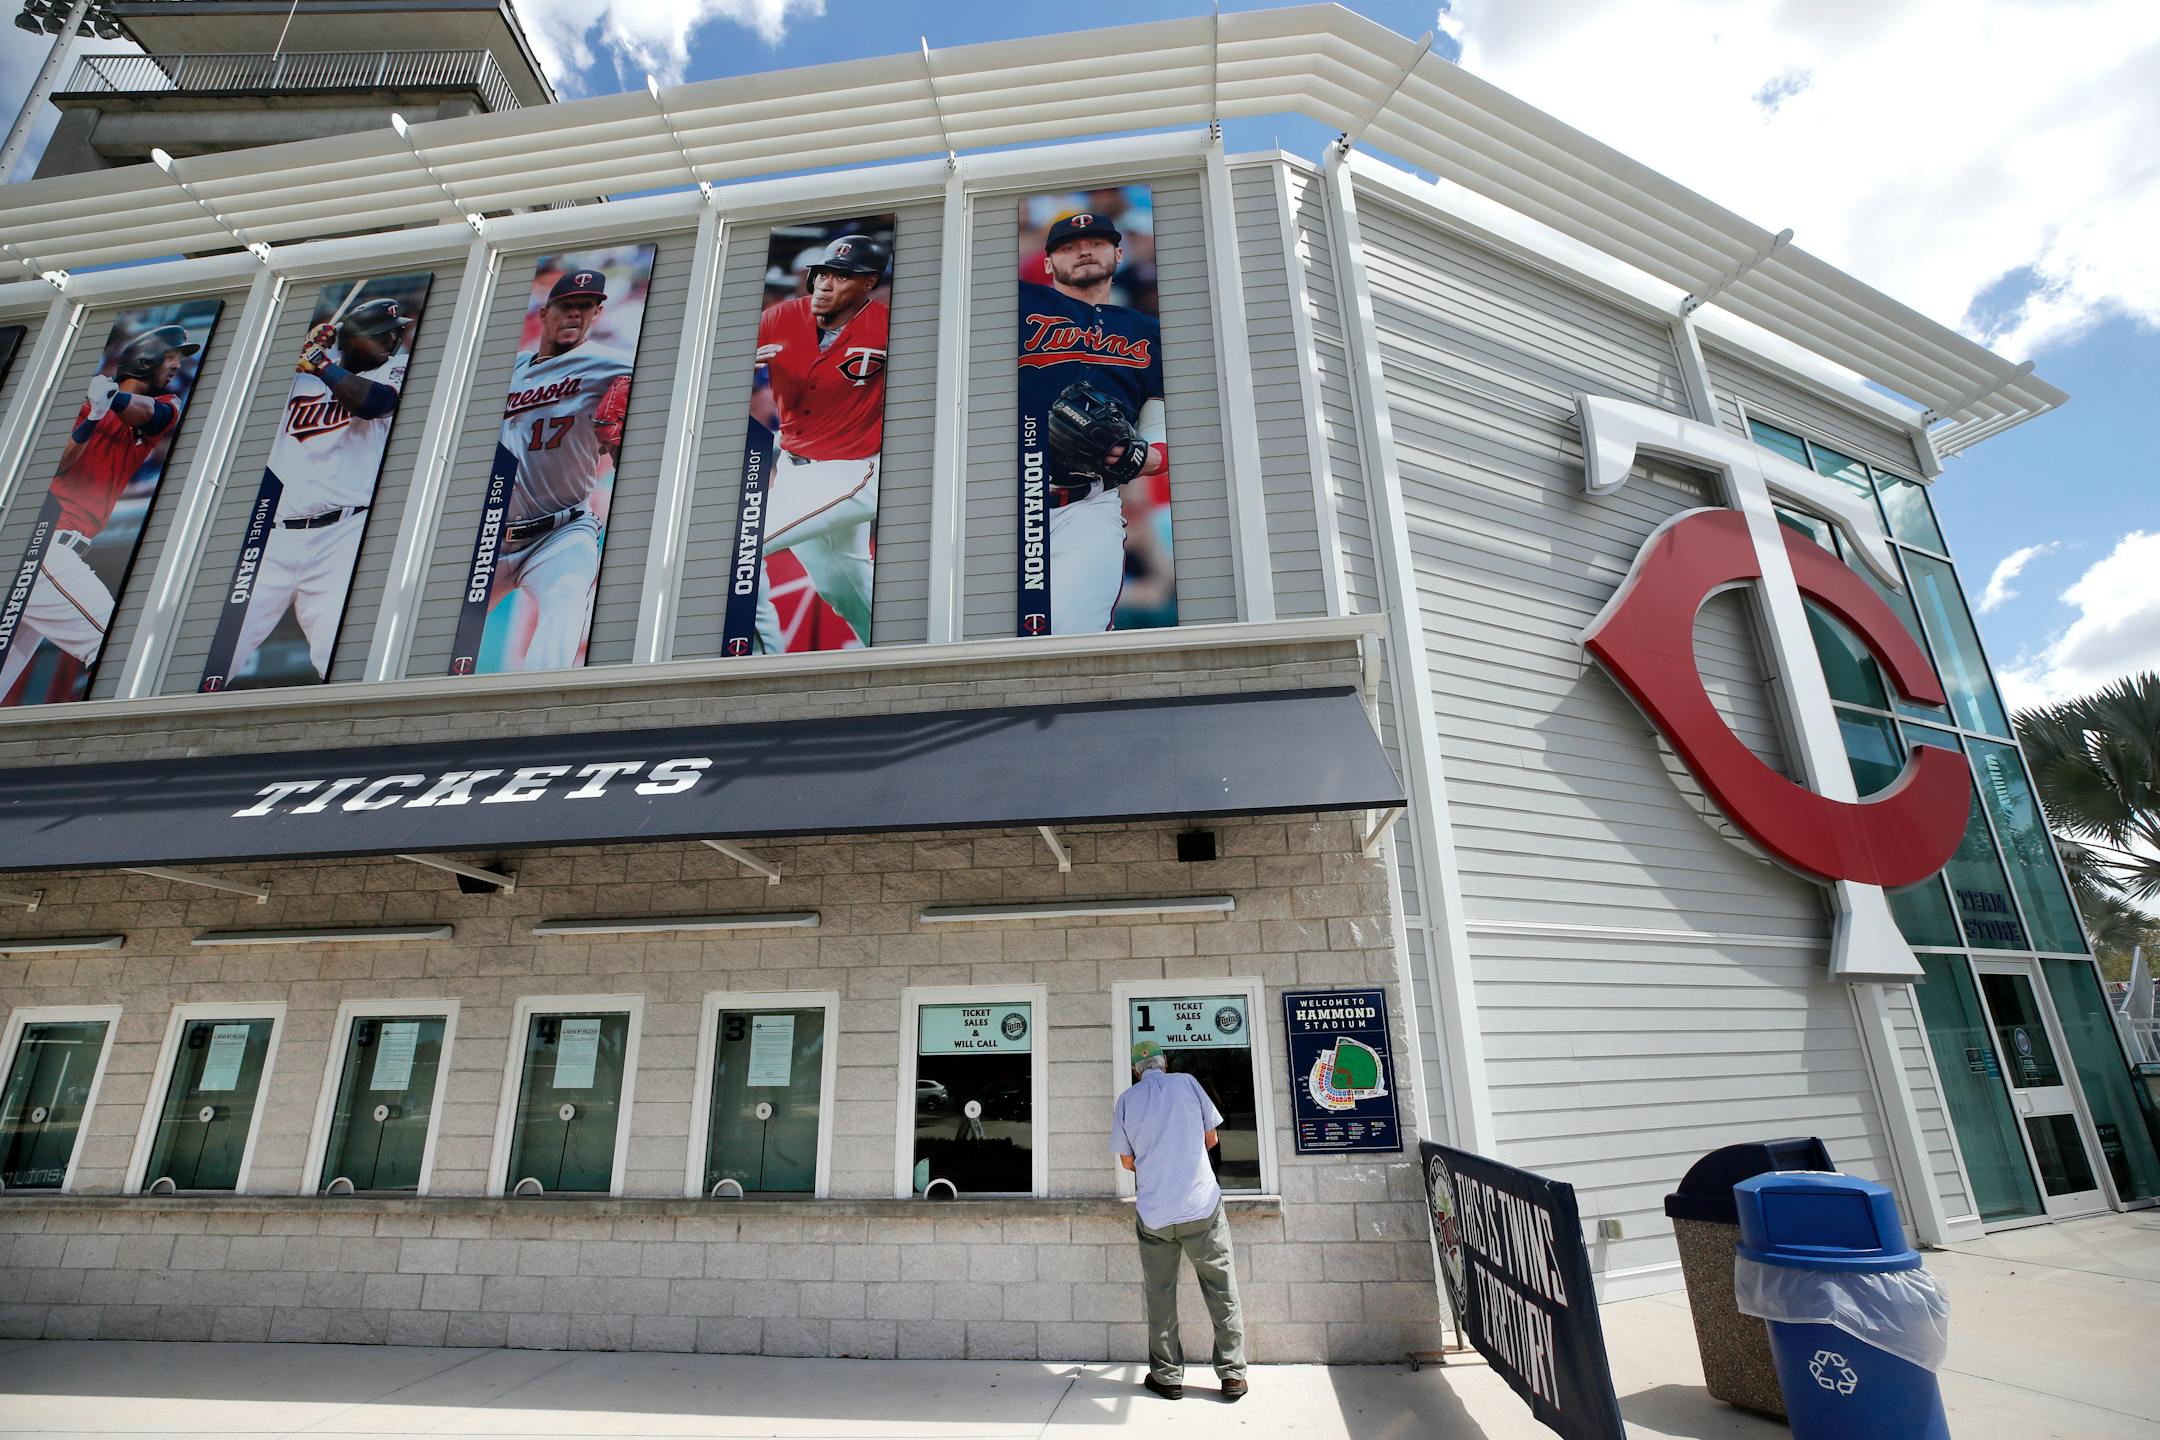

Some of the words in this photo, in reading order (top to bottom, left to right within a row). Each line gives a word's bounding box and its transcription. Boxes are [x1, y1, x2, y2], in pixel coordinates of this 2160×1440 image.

[1021, 313, 1152, 365] Twins
[1062, 404, 1091, 427] marucci
[528, 415, 575, 451] 17
[1025, 415, 1037, 447] JOSH
[746, 449, 761, 489] JORGE
[489, 474, 505, 505] JOSÉ
[248, 498, 271, 544] MIGUEL
[1024, 451, 1045, 590] DONALDSON
[28, 521, 49, 556] EDDIE
[734, 491, 763, 596] POLANCO
[468, 507, 503, 603] BERRÍOS
[230, 546, 261, 604] SANÓ
[0, 559, 39, 650] ROSARIO
[230, 757, 714, 818] TICKETS
[1956, 889, 2009, 913] TEAM
[1964, 919, 2022, 941] STORE
[961, 1009, 991, 1017] TICKET
[1173, 1002, 1204, 1011] TICKET
[1296, 1007, 1376, 1021] HAMMOND
[1300, 999, 1350, 1007] WELCOME
[1352, 998, 1365, 1006] TO
[726, 1016, 746, 1042] 3
[964, 1019, 989, 1027] SALES
[1137, 1006, 1155, 1032] 1
[1176, 1012, 1201, 1020] SALES
[1185, 1023, 1193, 1031] &
[1304, 1020, 1367, 1030] STADIUM
[28, 1029, 48, 1052] 7
[357, 1022, 375, 1048] 5
[536, 1019, 556, 1045] 4
[972, 1029, 980, 1037] &
[977, 1040, 998, 1048] CALL
[1167, 1035, 1188, 1043] WILL
[1190, 1034, 1213, 1042] CALL
[1455, 1172, 1487, 1256] THIS
[1481, 1183, 1503, 1268] IS
[1496, 1189, 1569, 1308] TWINS
[1473, 1260, 1561, 1411] TERRITORY
